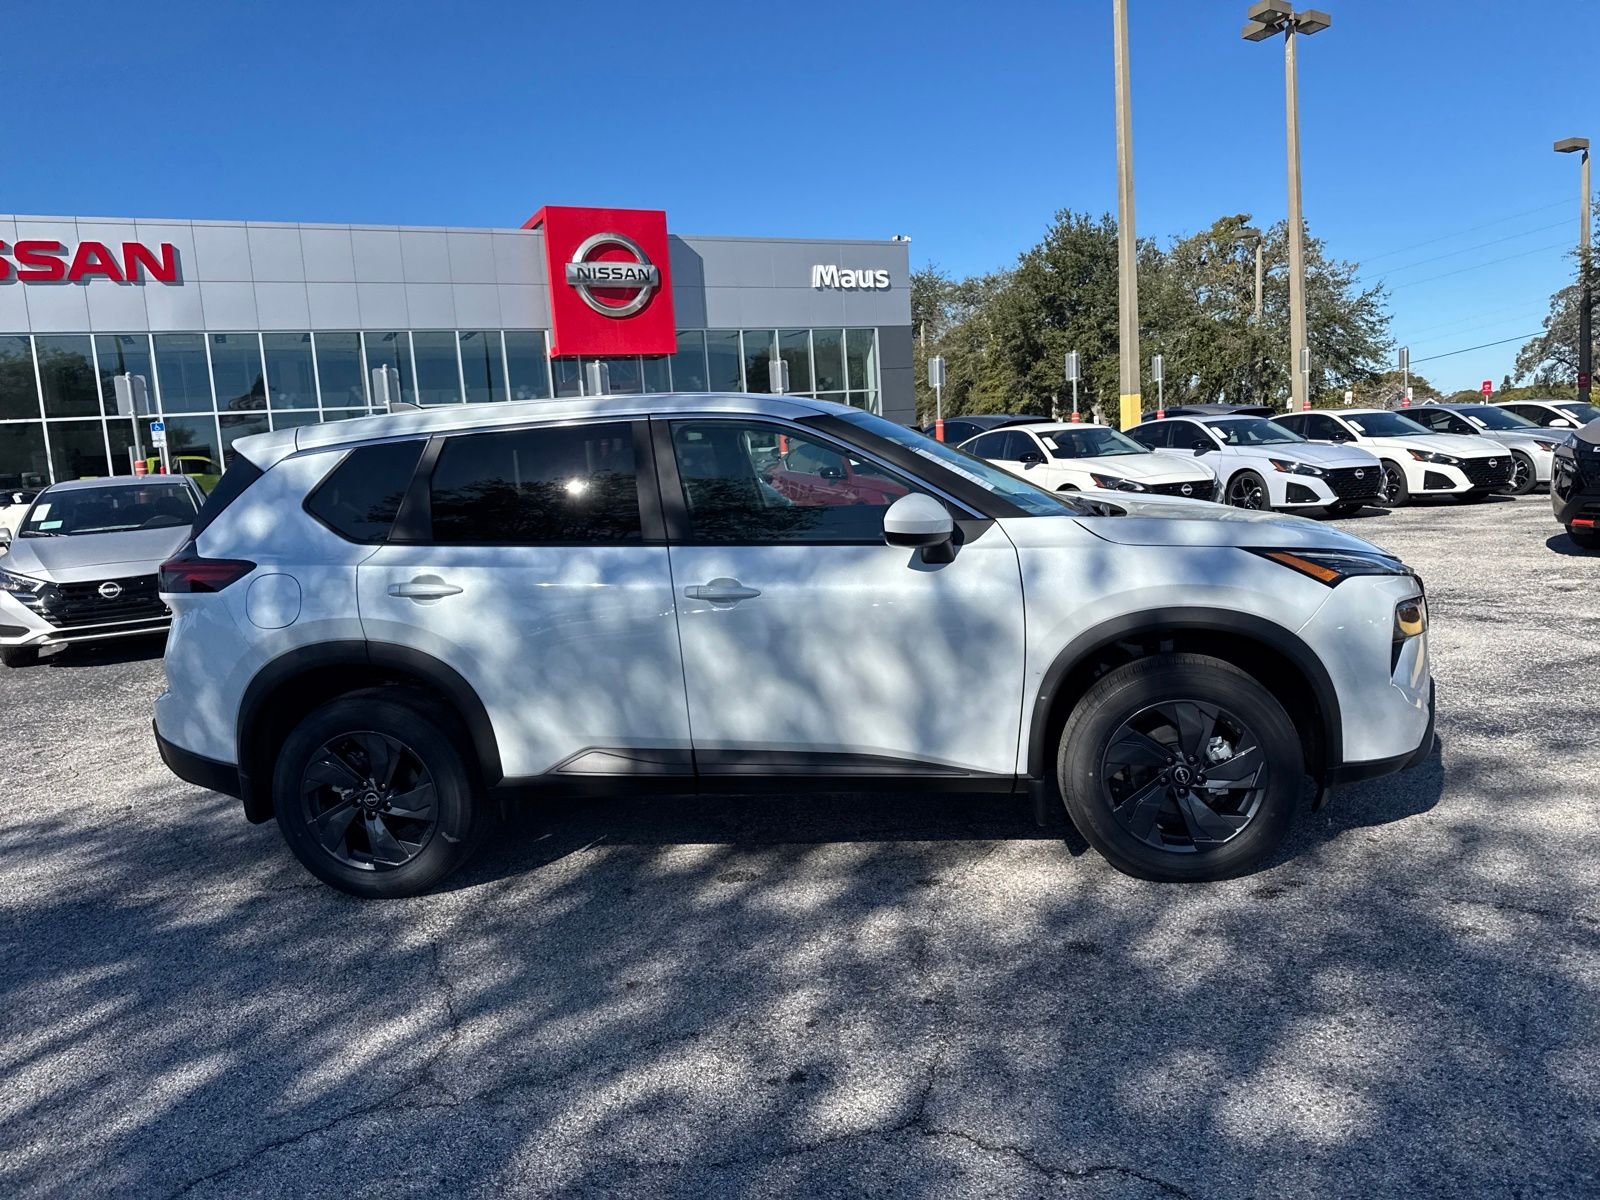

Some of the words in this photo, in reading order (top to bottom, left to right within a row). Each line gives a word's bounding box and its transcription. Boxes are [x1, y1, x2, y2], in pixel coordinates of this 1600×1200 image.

[0, 240, 177, 282] SAN
[577, 267, 650, 281] NISSAN
[812, 264, 890, 288] Maus
